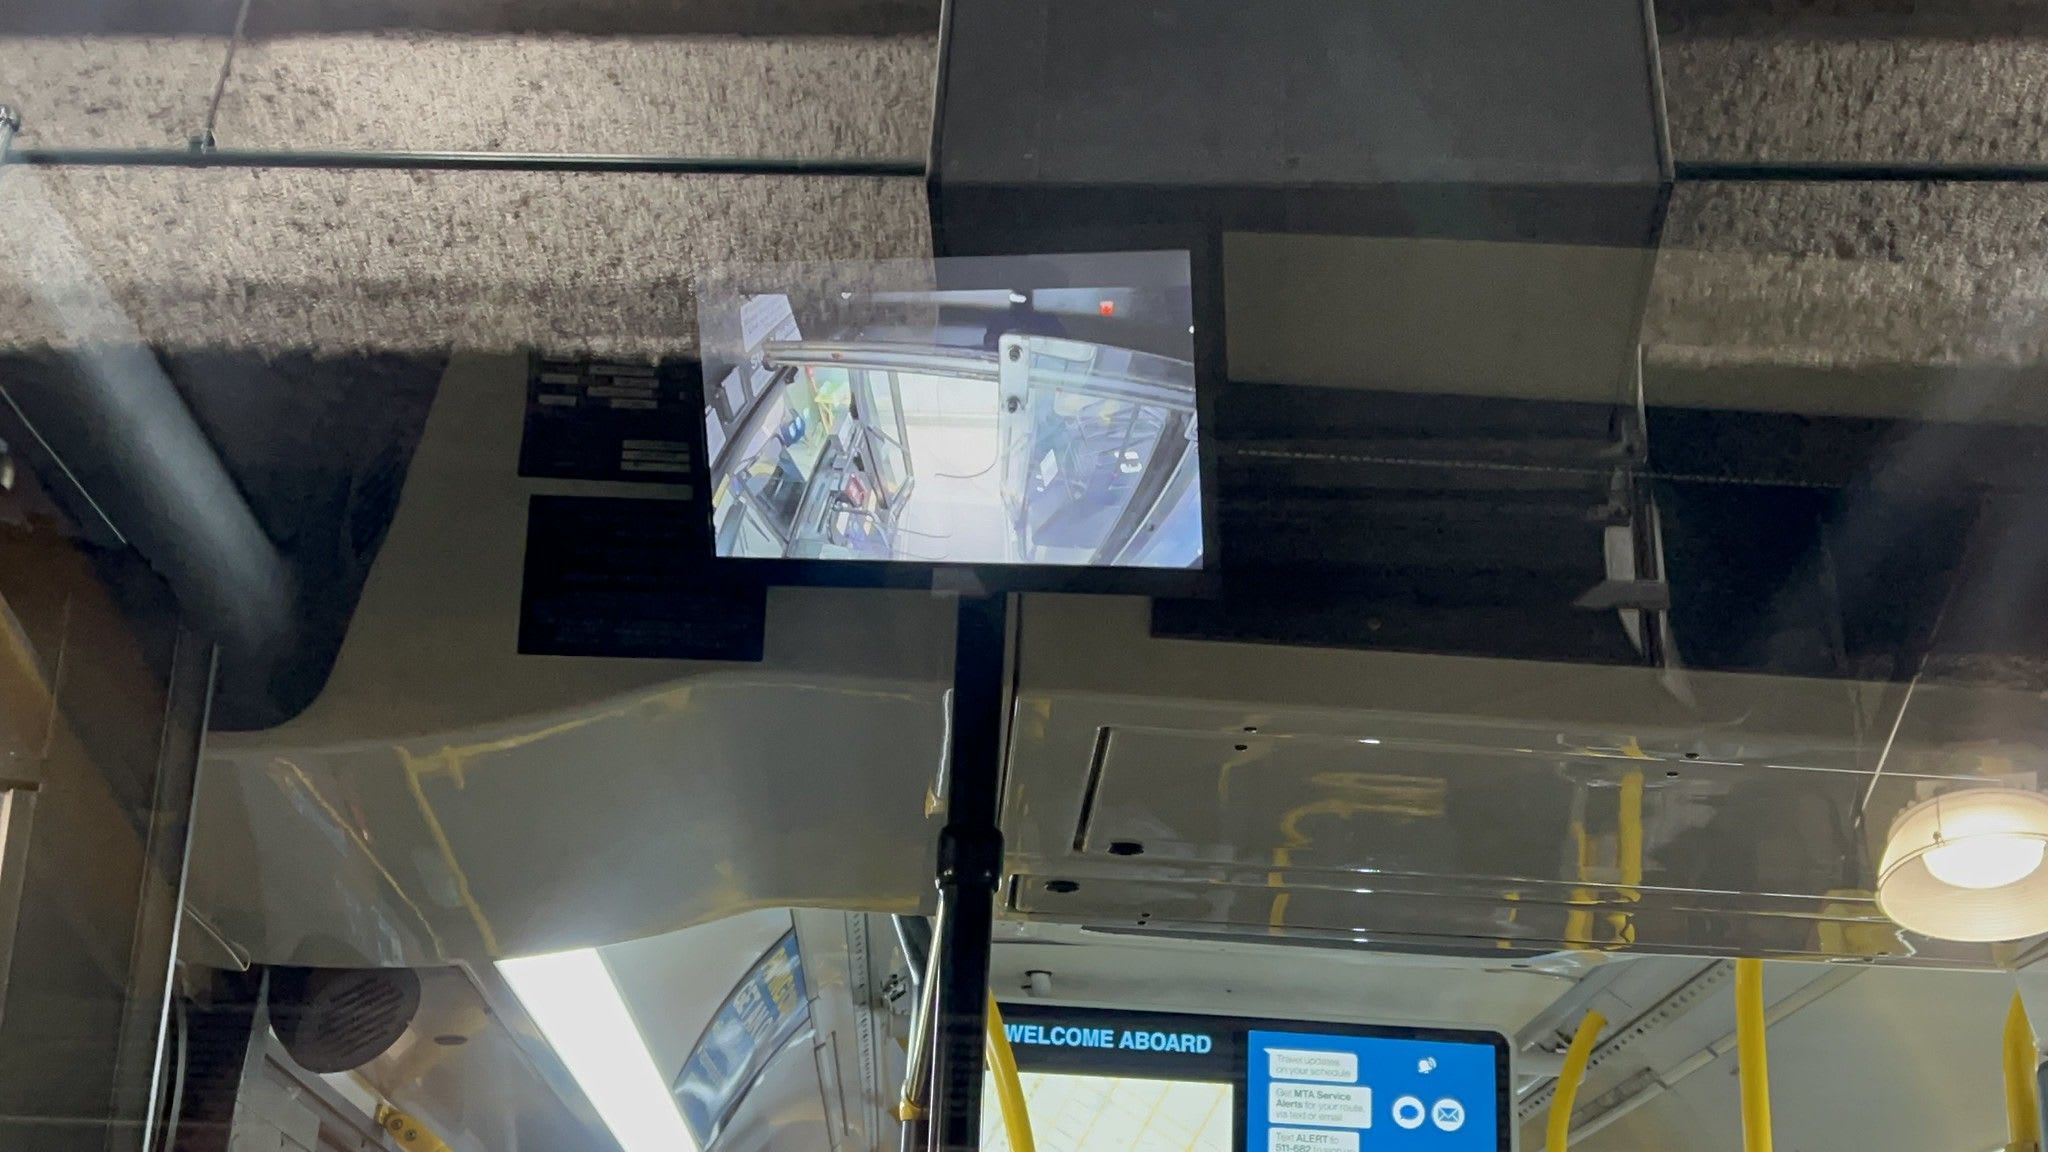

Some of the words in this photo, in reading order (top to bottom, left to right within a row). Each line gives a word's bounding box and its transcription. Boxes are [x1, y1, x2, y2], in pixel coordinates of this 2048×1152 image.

[1004, 1024, 1114, 1048] WELCOME
[1119, 1031, 1212, 1053] ABOARD
[1290, 1068, 1308, 1077] your
[1276, 1088, 1292, 1097] Get
[1294, 1089, 1315, 1099] MTA
[1317, 1090, 1351, 1101] Service
[1276, 1099, 1303, 1108] Alerts
[1305, 1101, 1316, 1109] for
[1319, 1103, 1338, 1112] your
[1289, 1111, 1306, 1119] text
[1276, 1132, 1294, 1141] Text
[1296, 1133, 1328, 1143] ALERT
[1330, 1136, 1339, 1144] to
